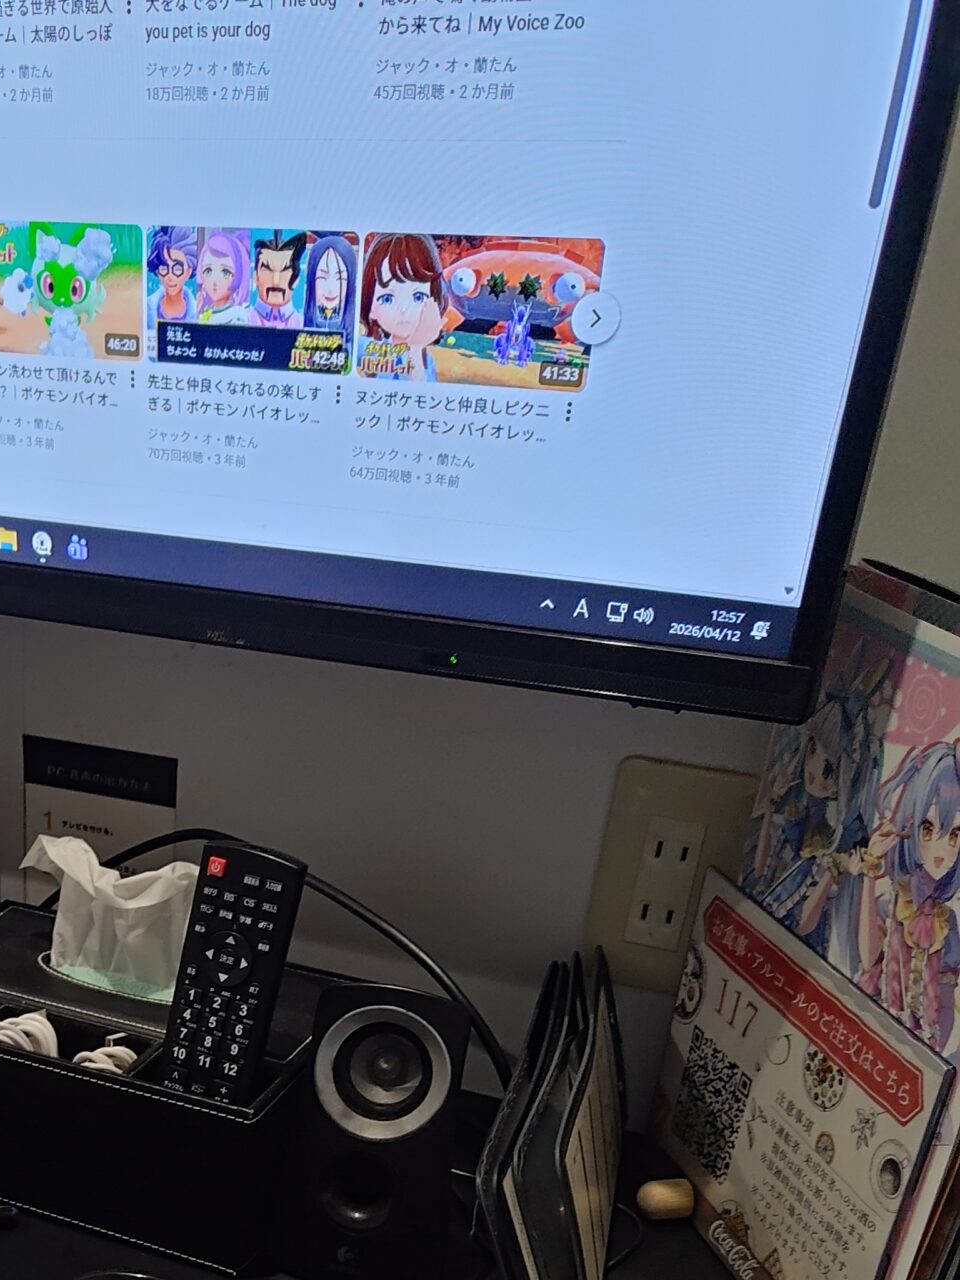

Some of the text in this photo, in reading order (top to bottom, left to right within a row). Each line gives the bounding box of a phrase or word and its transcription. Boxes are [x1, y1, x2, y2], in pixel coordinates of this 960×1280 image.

[145, 21, 271, 43] you pet is your dog
[478, 15, 502, 36] My
[507, 13, 549, 32] Voice
[554, 13, 585, 30] Zoo
[108, 337, 137, 352] 46:20
[312, 351, 346, 366] 42:48
[541, 365, 579, 382] 41:33
[147, 374, 323, 404] 先生と仲良くなれるの楽しす
[710, 609, 746, 624] 12:57
[668, 622, 742, 643] 2026/04/12
[43, 810, 52, 830] 1
[243, 898, 255, 908] CS
[189, 990, 195, 1000] 1
[212, 998, 222, 1008] 2
[239, 1005, 247, 1016] 3
[713, 977, 758, 1039] 117
[182, 1009, 191, 1020] 4
[208, 1017, 217, 1028] 5
[234, 1025, 243, 1035] 6
[179, 1028, 239, 1055] 7 8 9
[172, 1046, 238, 1076] 10 11 12
